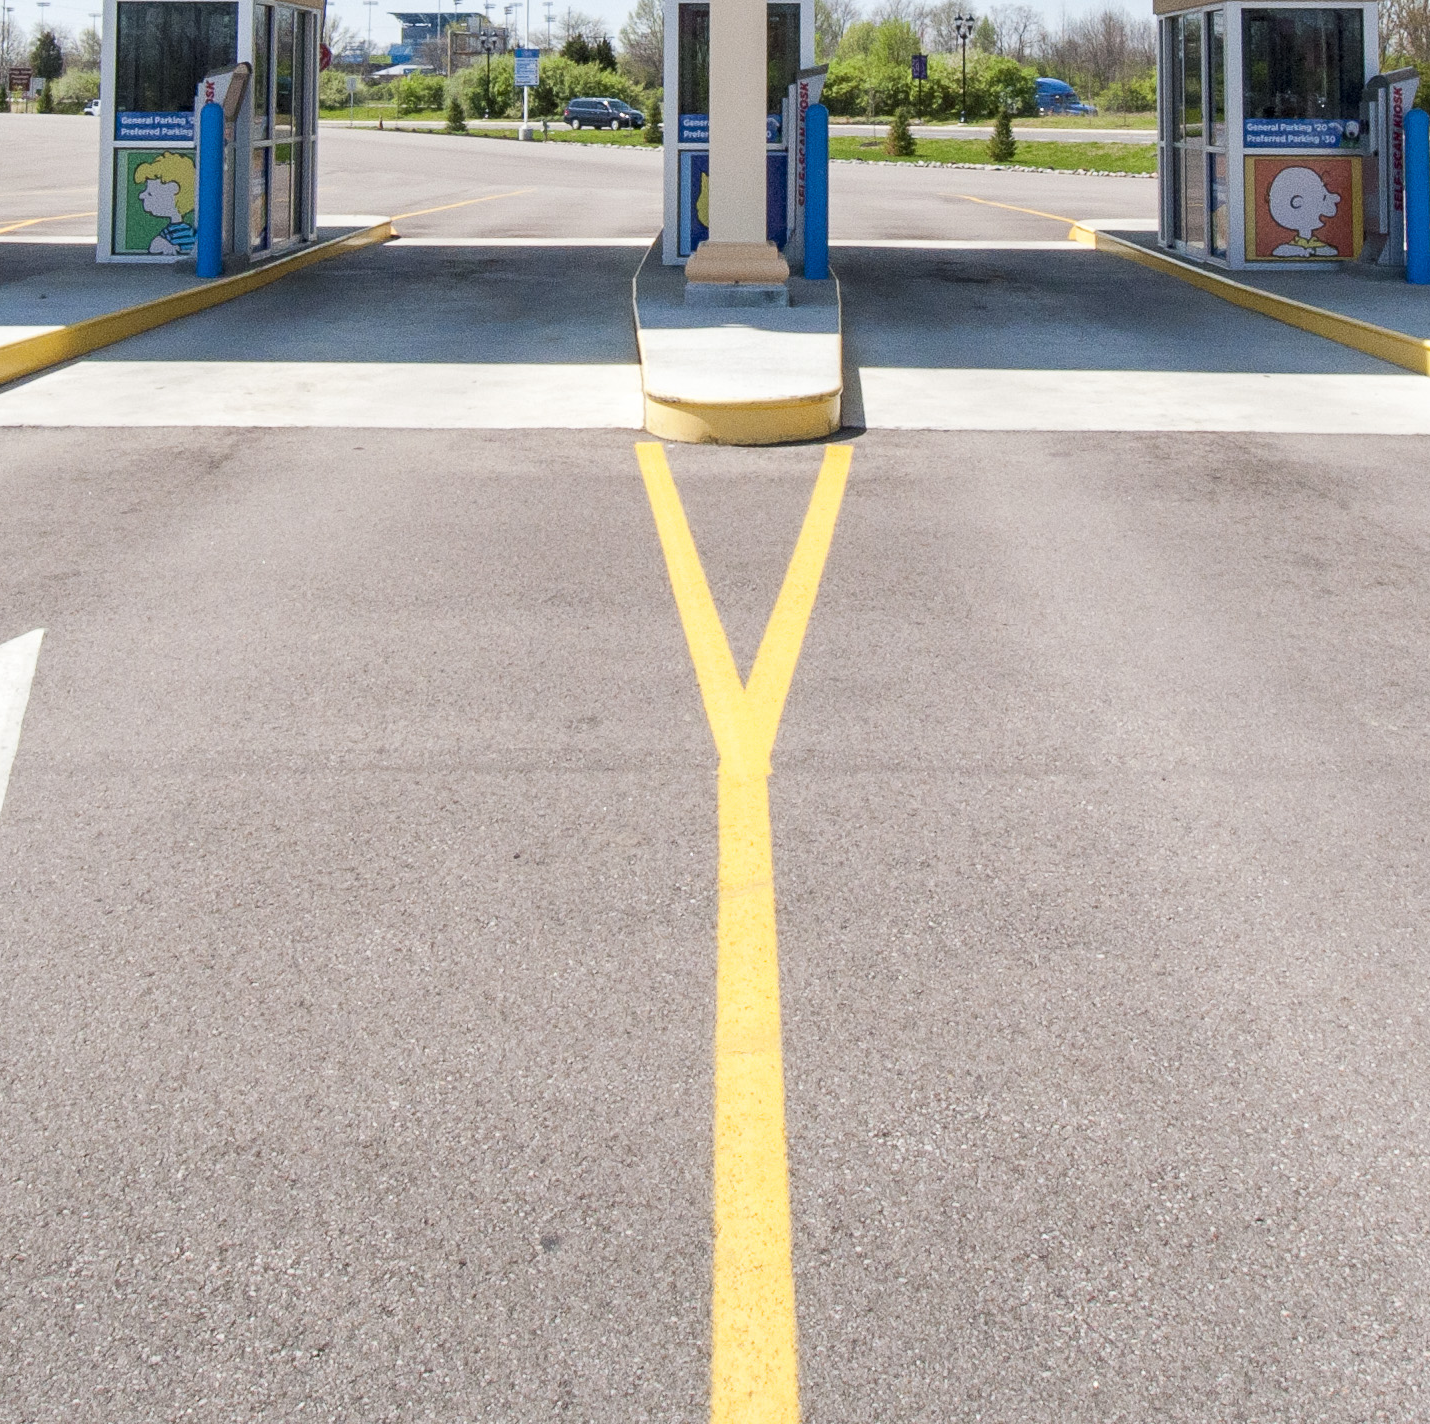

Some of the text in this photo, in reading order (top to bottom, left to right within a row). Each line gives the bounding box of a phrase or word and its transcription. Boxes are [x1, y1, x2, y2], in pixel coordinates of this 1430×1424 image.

[121, 117, 153, 125] General
[155, 117, 186, 126] Parking
[121, 128, 193, 137] Preferred Parking
[1247, 123, 1328, 133] General Parking $20
[1247, 135, 1336, 145] Preferred Parking $30
[1393, 87, 1403, 211] SELF-SCAN KIOSK
